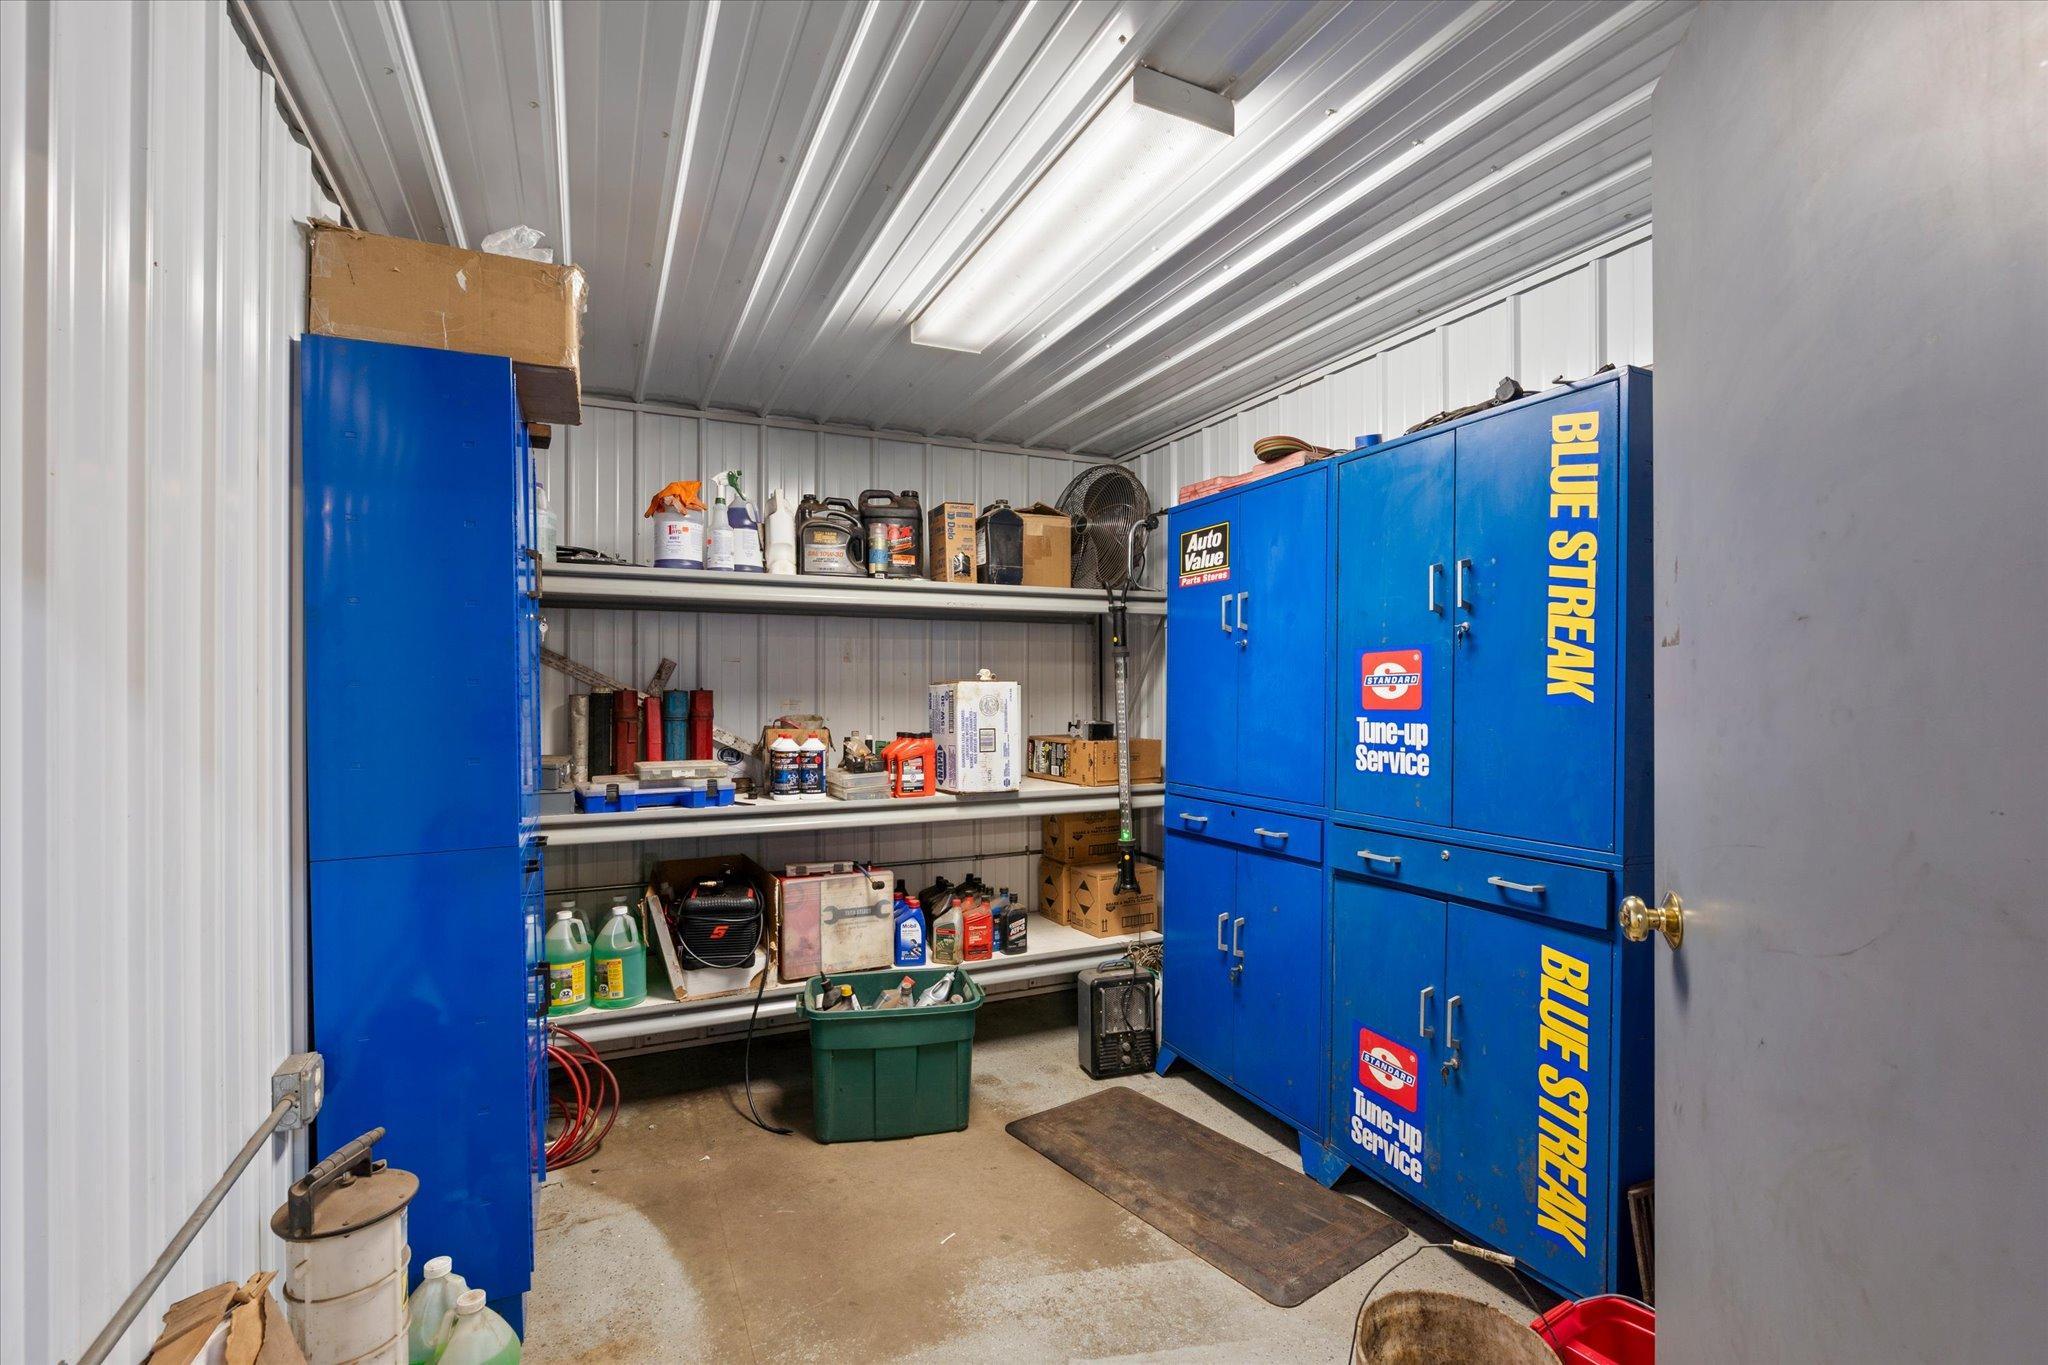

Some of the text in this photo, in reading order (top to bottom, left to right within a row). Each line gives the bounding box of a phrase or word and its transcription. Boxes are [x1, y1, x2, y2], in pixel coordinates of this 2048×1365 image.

[947, 521, 956, 540] Delo
[1186, 529, 1222, 553] Auto
[1184, 549, 1225, 572] Value
[1547, 410, 1599, 704] BLUE STREAK
[1181, 571, 1228, 587] Parts Stores
[1366, 674, 1418, 686] STANDARD
[1356, 717, 1428, 750] Tune-up
[1355, 744, 1430, 776] Service
[1363, 1053, 1414, 1085] STANDARD
[1537, 944, 1589, 1258] BLUE STREAK
[1353, 1087, 1422, 1155] Tune-up
[1351, 1115, 1422, 1183] Service
